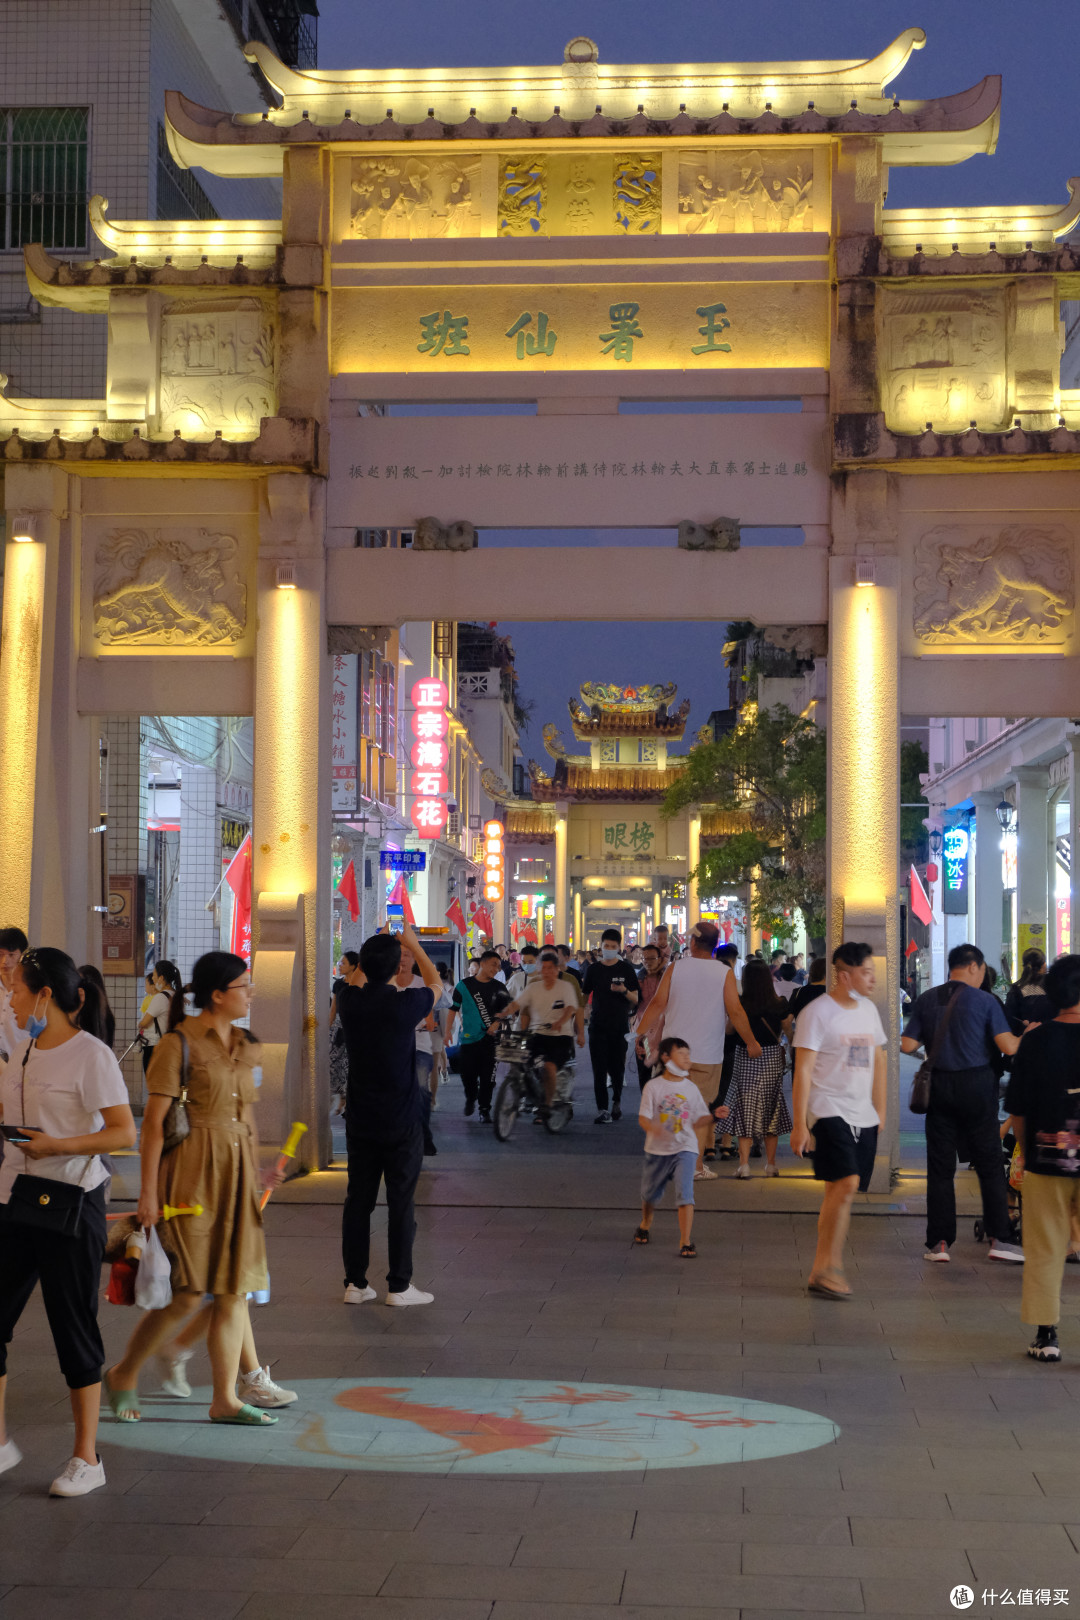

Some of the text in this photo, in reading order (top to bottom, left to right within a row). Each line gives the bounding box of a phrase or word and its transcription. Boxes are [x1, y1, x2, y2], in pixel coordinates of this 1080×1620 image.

[416, 682, 443, 827] 正宗海石花
[383, 853, 421, 863] 东平印章
